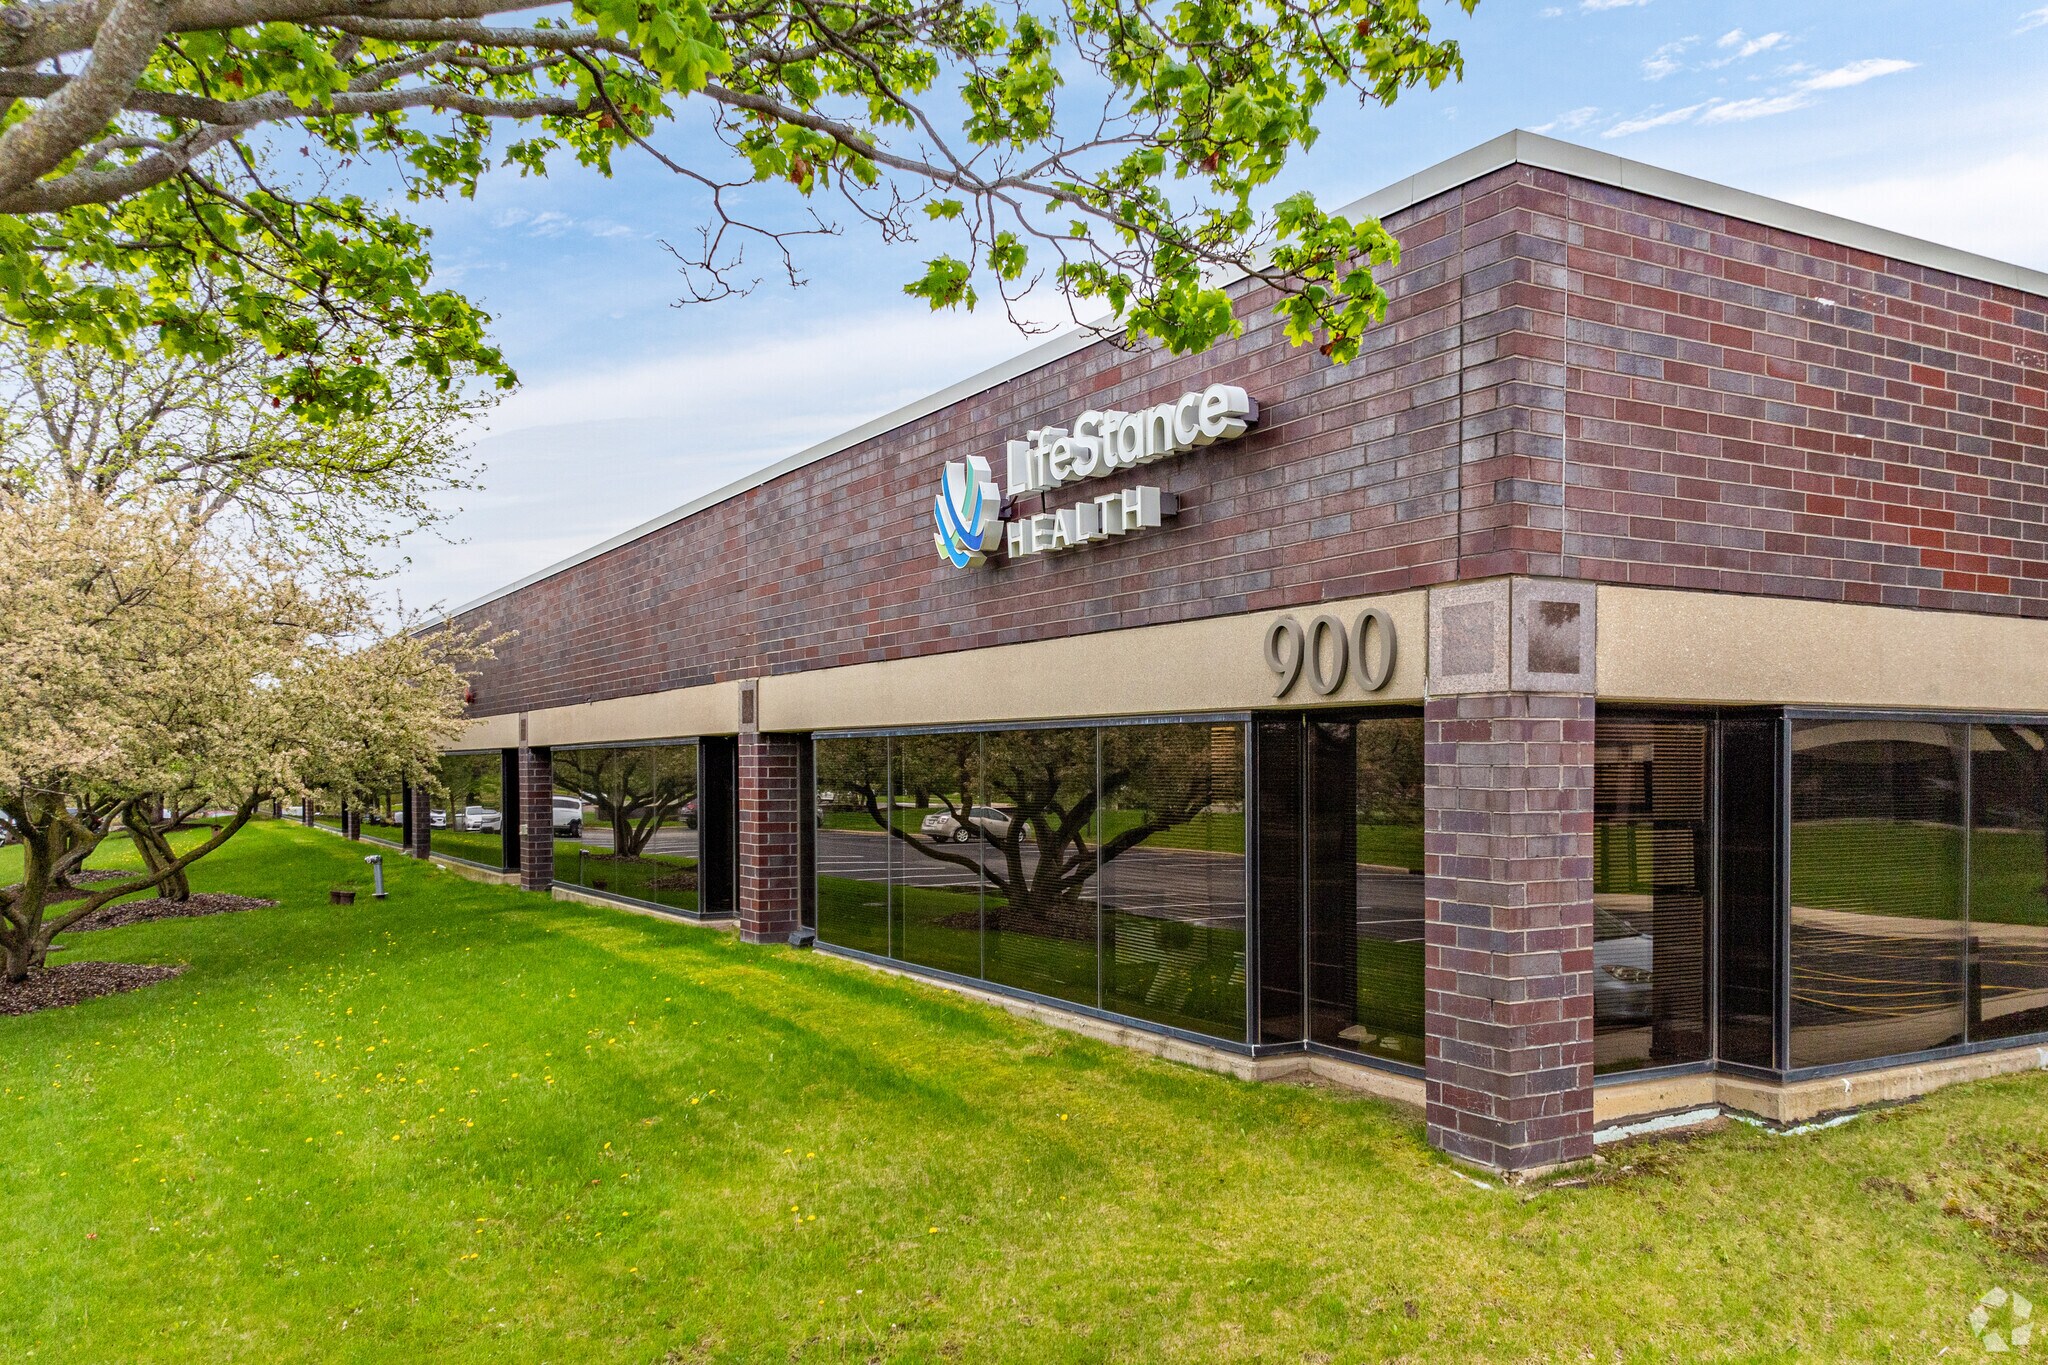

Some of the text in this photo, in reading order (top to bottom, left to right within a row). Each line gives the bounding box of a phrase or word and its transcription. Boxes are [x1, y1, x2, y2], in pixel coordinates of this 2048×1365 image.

[1007, 383, 1249, 496] LifeStance
[1007, 485, 1161, 558] HEALTH
[1264, 607, 1398, 698] 900
